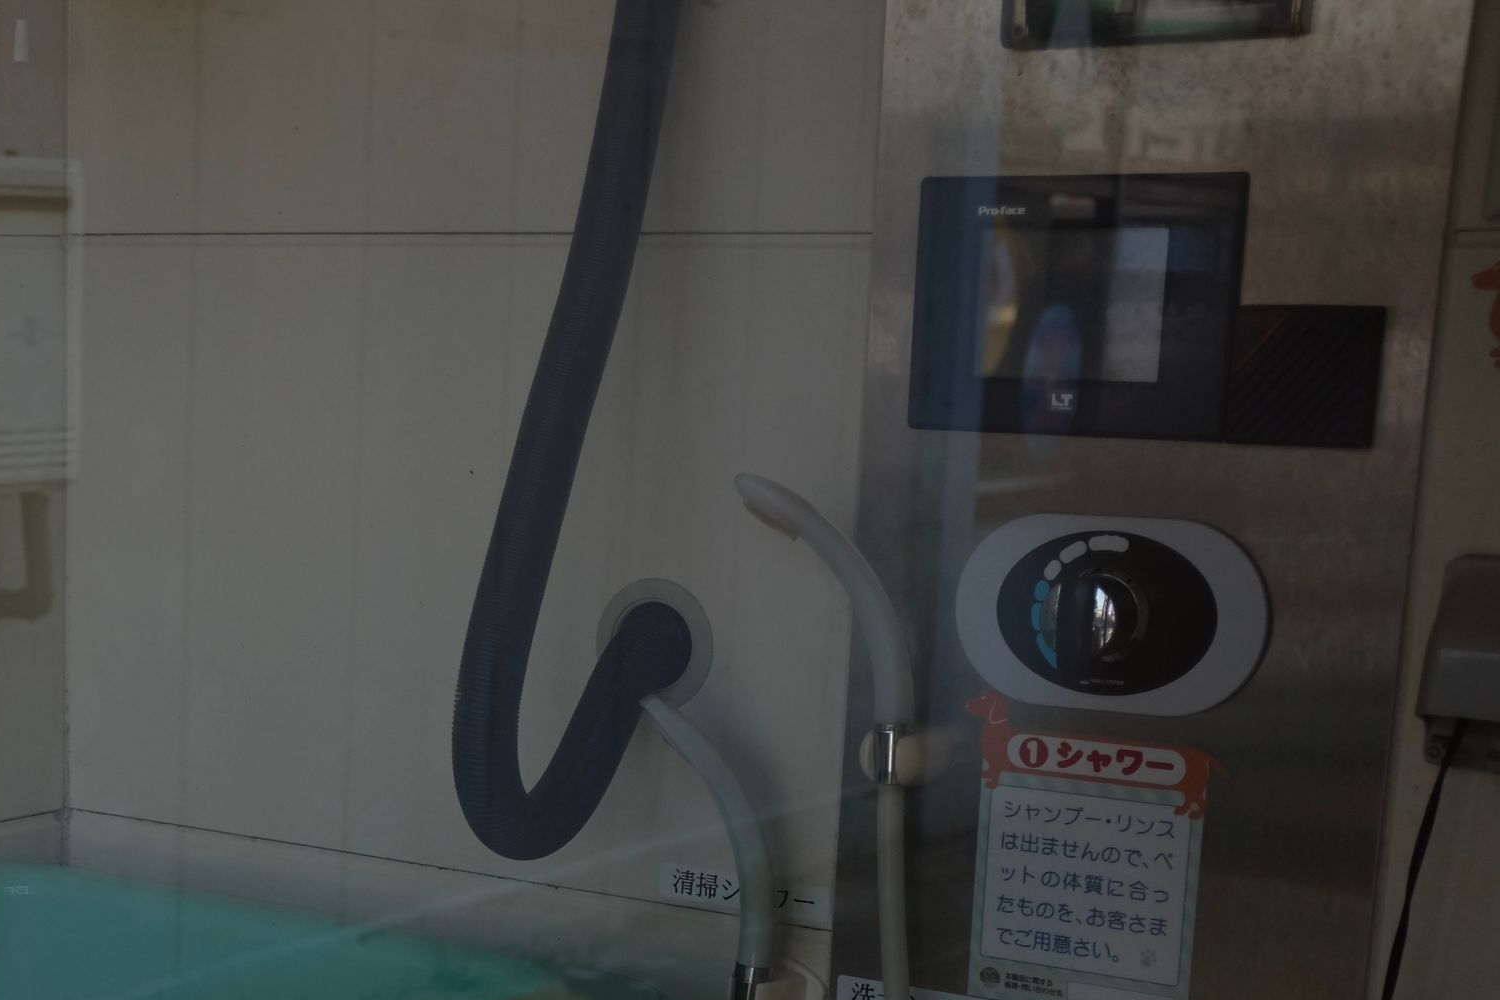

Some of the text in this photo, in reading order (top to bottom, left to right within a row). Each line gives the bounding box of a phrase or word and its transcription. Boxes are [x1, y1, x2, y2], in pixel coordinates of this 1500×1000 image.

[1003, 800, 1176, 839] シャンプー・リンス
[1001, 831, 1174, 870] は出ませんので、ペ
[672, 868, 815, 909] 清掃シワー
[1000, 865, 1170, 903] ットの体質に合っ
[996, 895, 1169, 937] たものを、お客さま
[996, 927, 1121, 964] でご用意さい。
